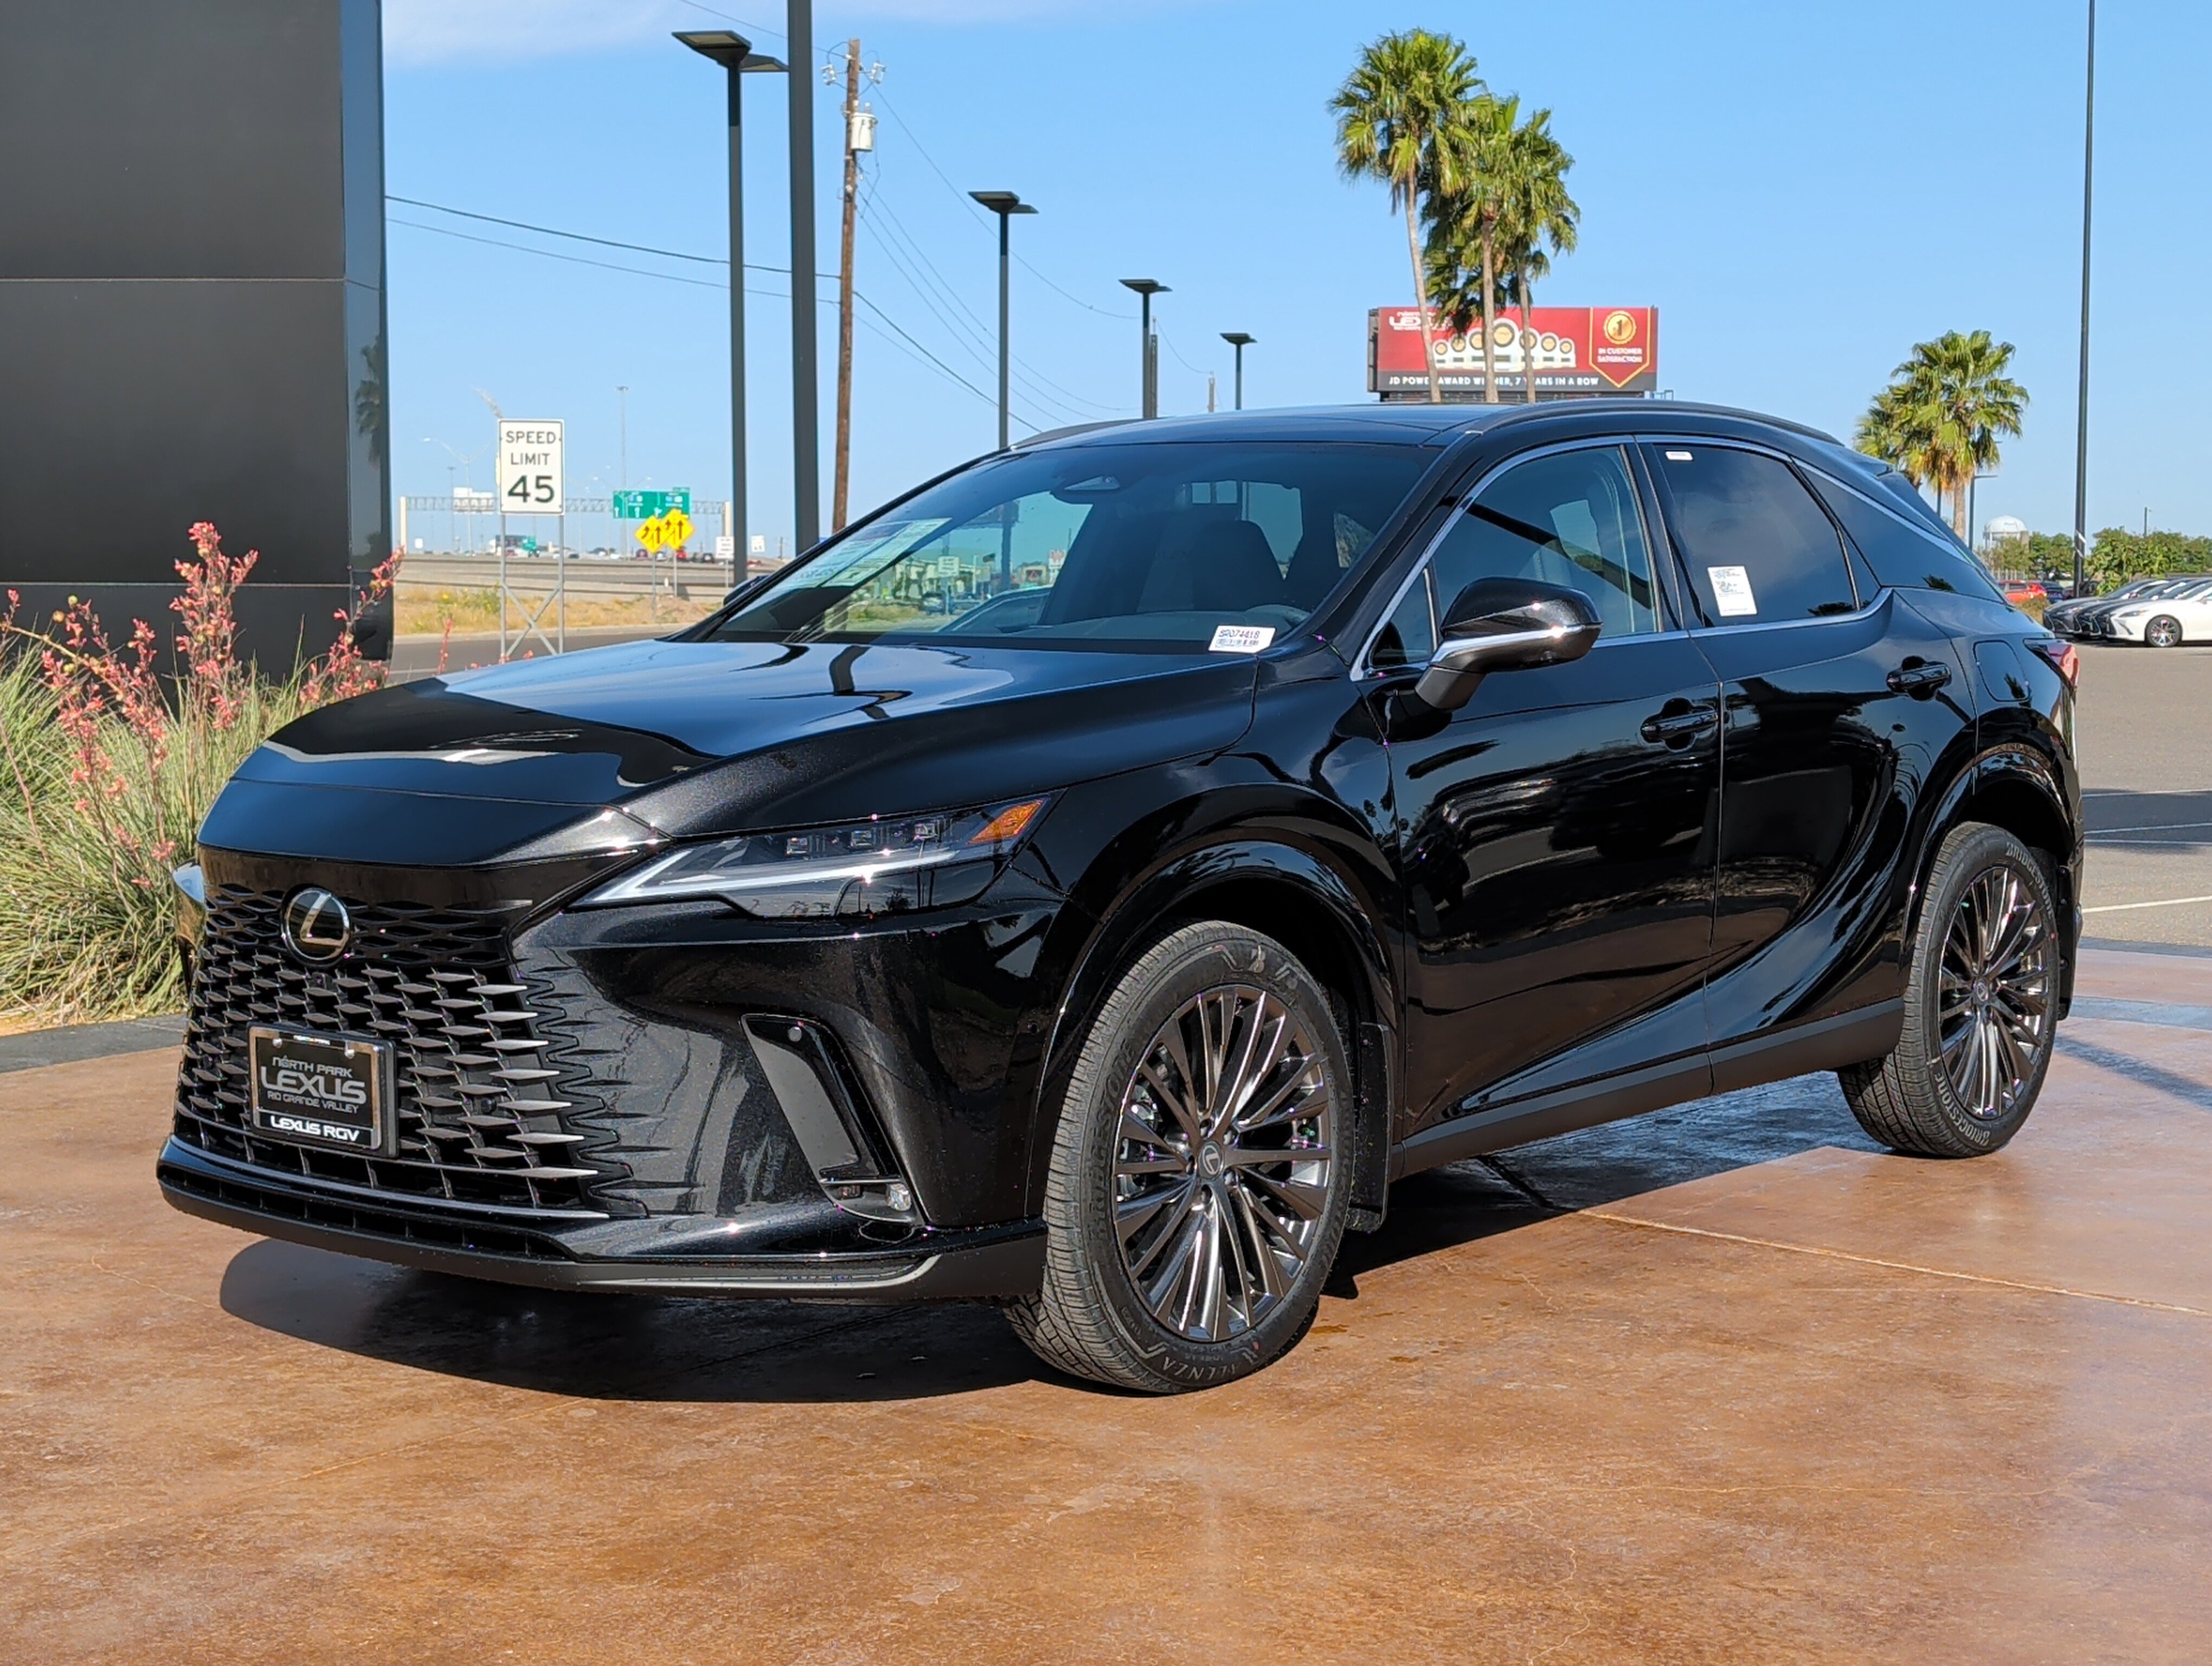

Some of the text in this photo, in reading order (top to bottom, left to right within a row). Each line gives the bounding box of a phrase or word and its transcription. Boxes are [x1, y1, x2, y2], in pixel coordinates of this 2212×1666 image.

[1389, 376, 1400, 385] JD
[1403, 376, 1430, 385] POWE
[1438, 376, 1471, 385] AWARD
[1555, 377, 1566, 386] IN
[1568, 377, 1575, 385] A
[1577, 377, 1599, 386] ROW
[505, 431, 557, 444] SPEED
[510, 453, 550, 465] LIMIT
[507, 475, 555, 503] 45
[317, 1064, 352, 1078] PARK
[261, 1066, 366, 1104] LEXUS
[282, 1093, 320, 1107] GRANDE
[321, 1100, 359, 1114] VALLEY
[271, 1116, 321, 1135] LEXUS
